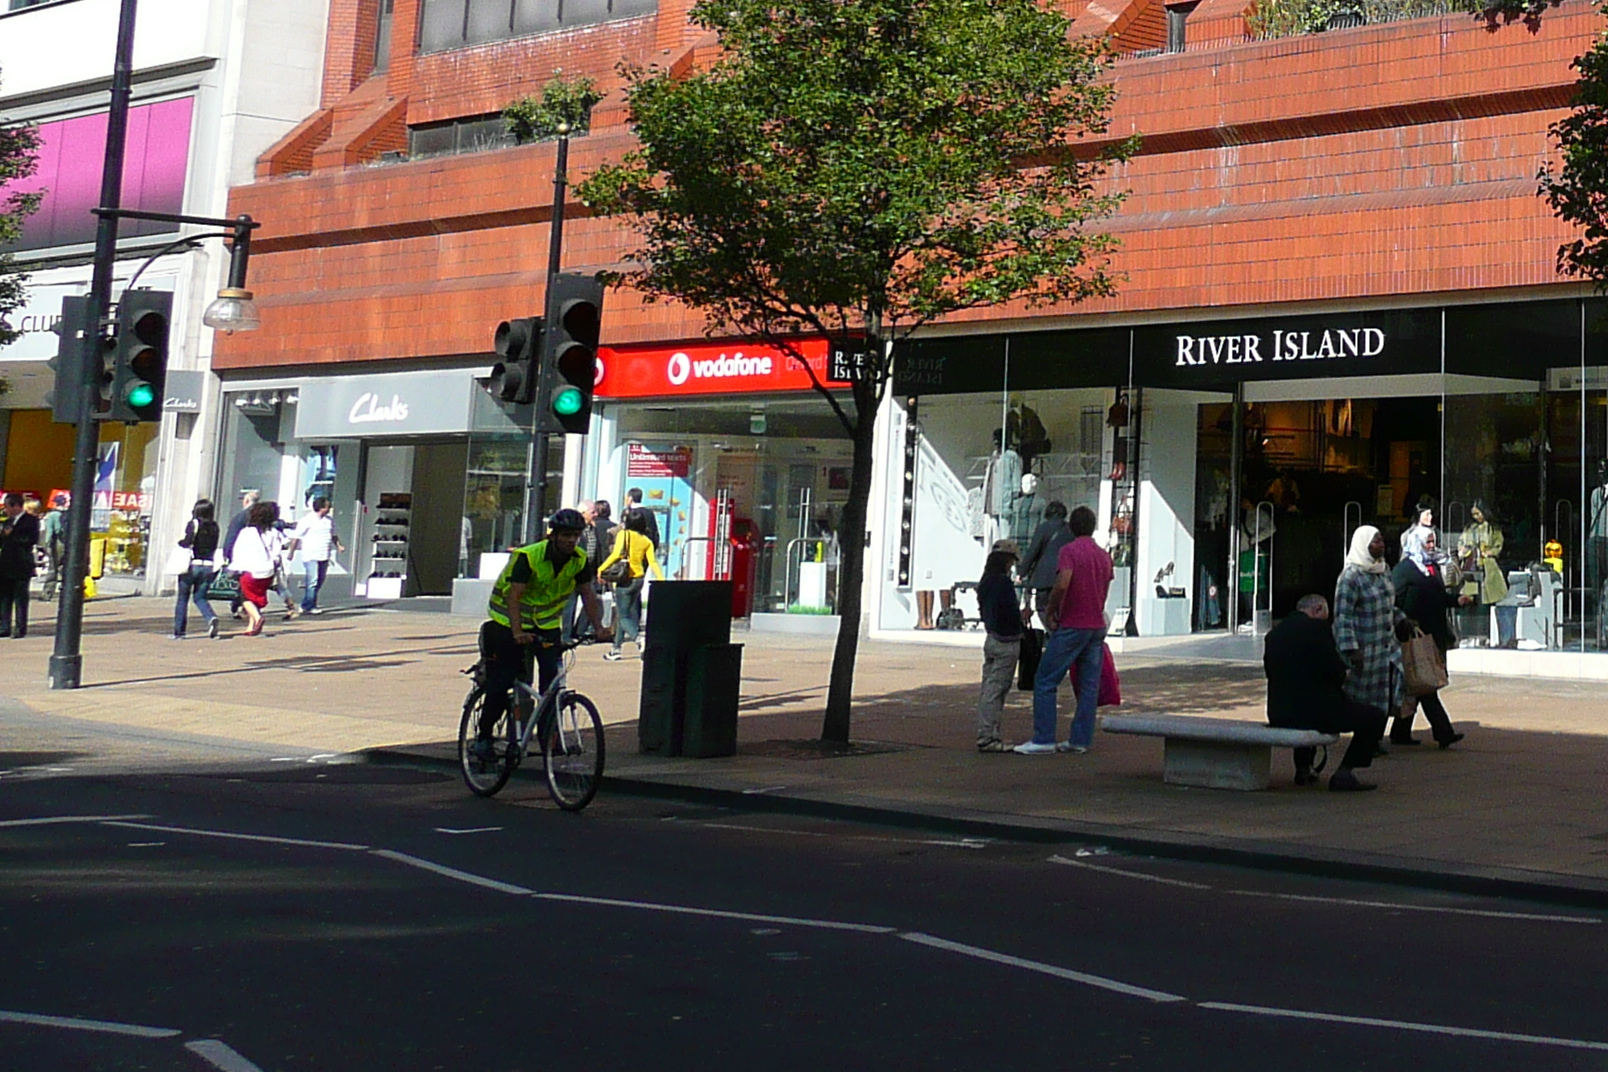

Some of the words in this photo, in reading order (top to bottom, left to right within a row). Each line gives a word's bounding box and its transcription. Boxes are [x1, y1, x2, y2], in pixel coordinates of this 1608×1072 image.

[1176, 333, 1263, 366] RIVER
[1273, 327, 1385, 361] ISLAND
[693, 352, 773, 378] vodafone
[163, 397, 197, 409] Clarks
[349, 392, 409, 424] Clarks
